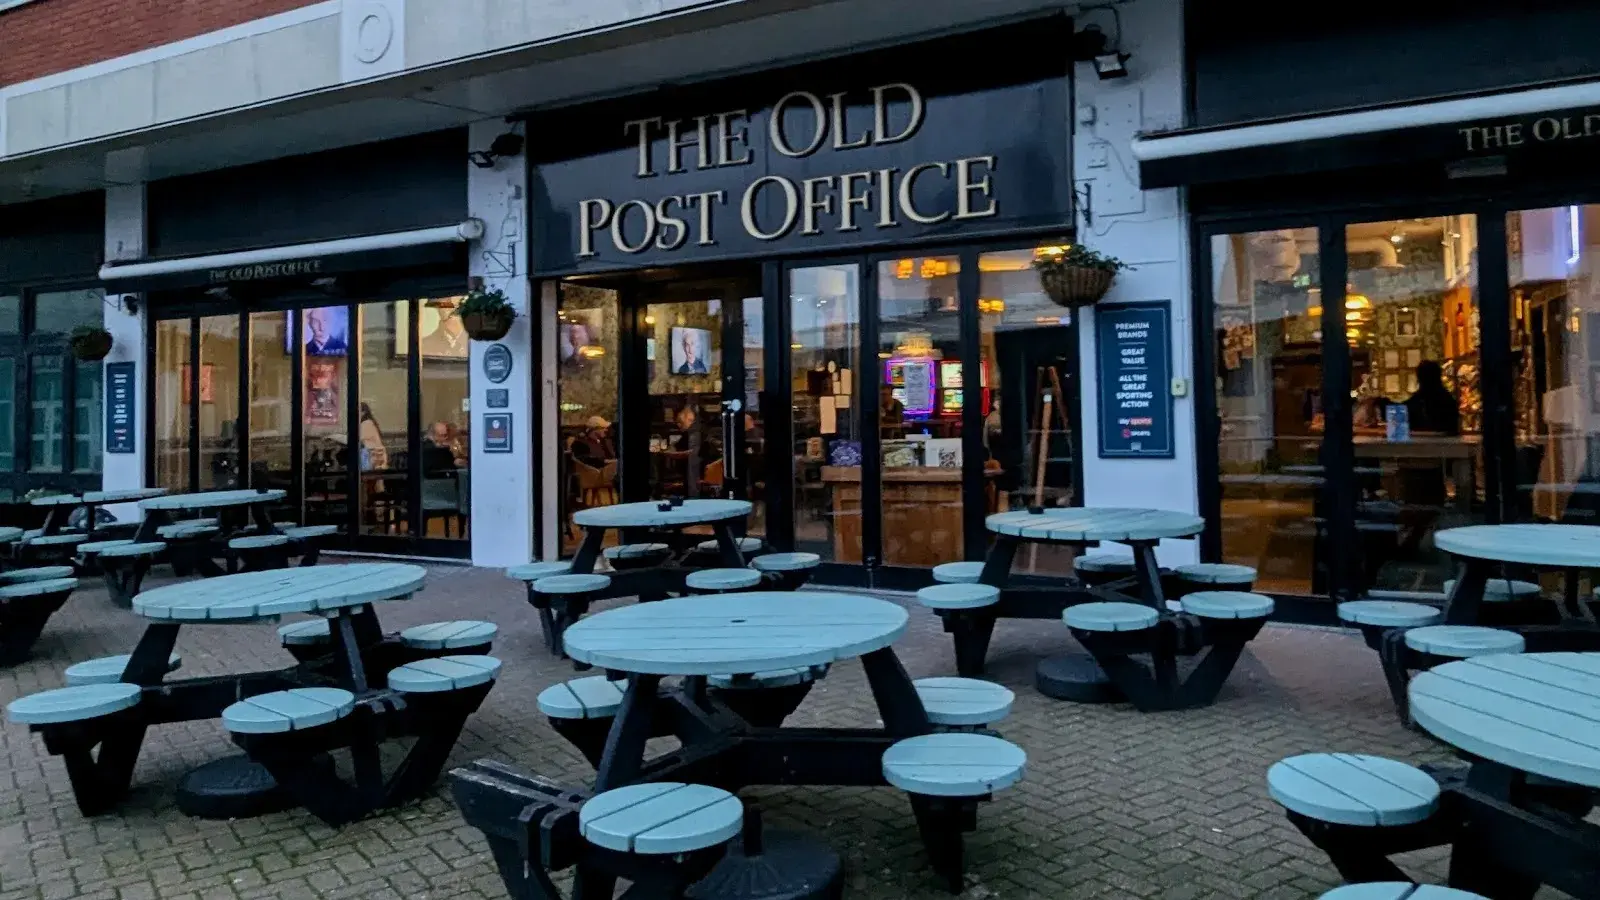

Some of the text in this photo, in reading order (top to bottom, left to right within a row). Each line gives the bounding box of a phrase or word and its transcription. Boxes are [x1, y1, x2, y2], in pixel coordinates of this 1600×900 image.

[624, 82, 924, 177] THE OLD
[1459, 123, 1524, 150] THE
[576, 155, 998, 257] POST OFFICE
[1115, 322, 1150, 330] PREMIUM
[1117, 331, 1148, 339] BRANDS
[1120, 348, 1146, 356] GREAT
[1121, 357, 1146, 365] VALUE
[1132, 374, 1148, 382] THE
[1122, 383, 1147, 391] GREAT
[1116, 392, 1153, 400] SPORTING
